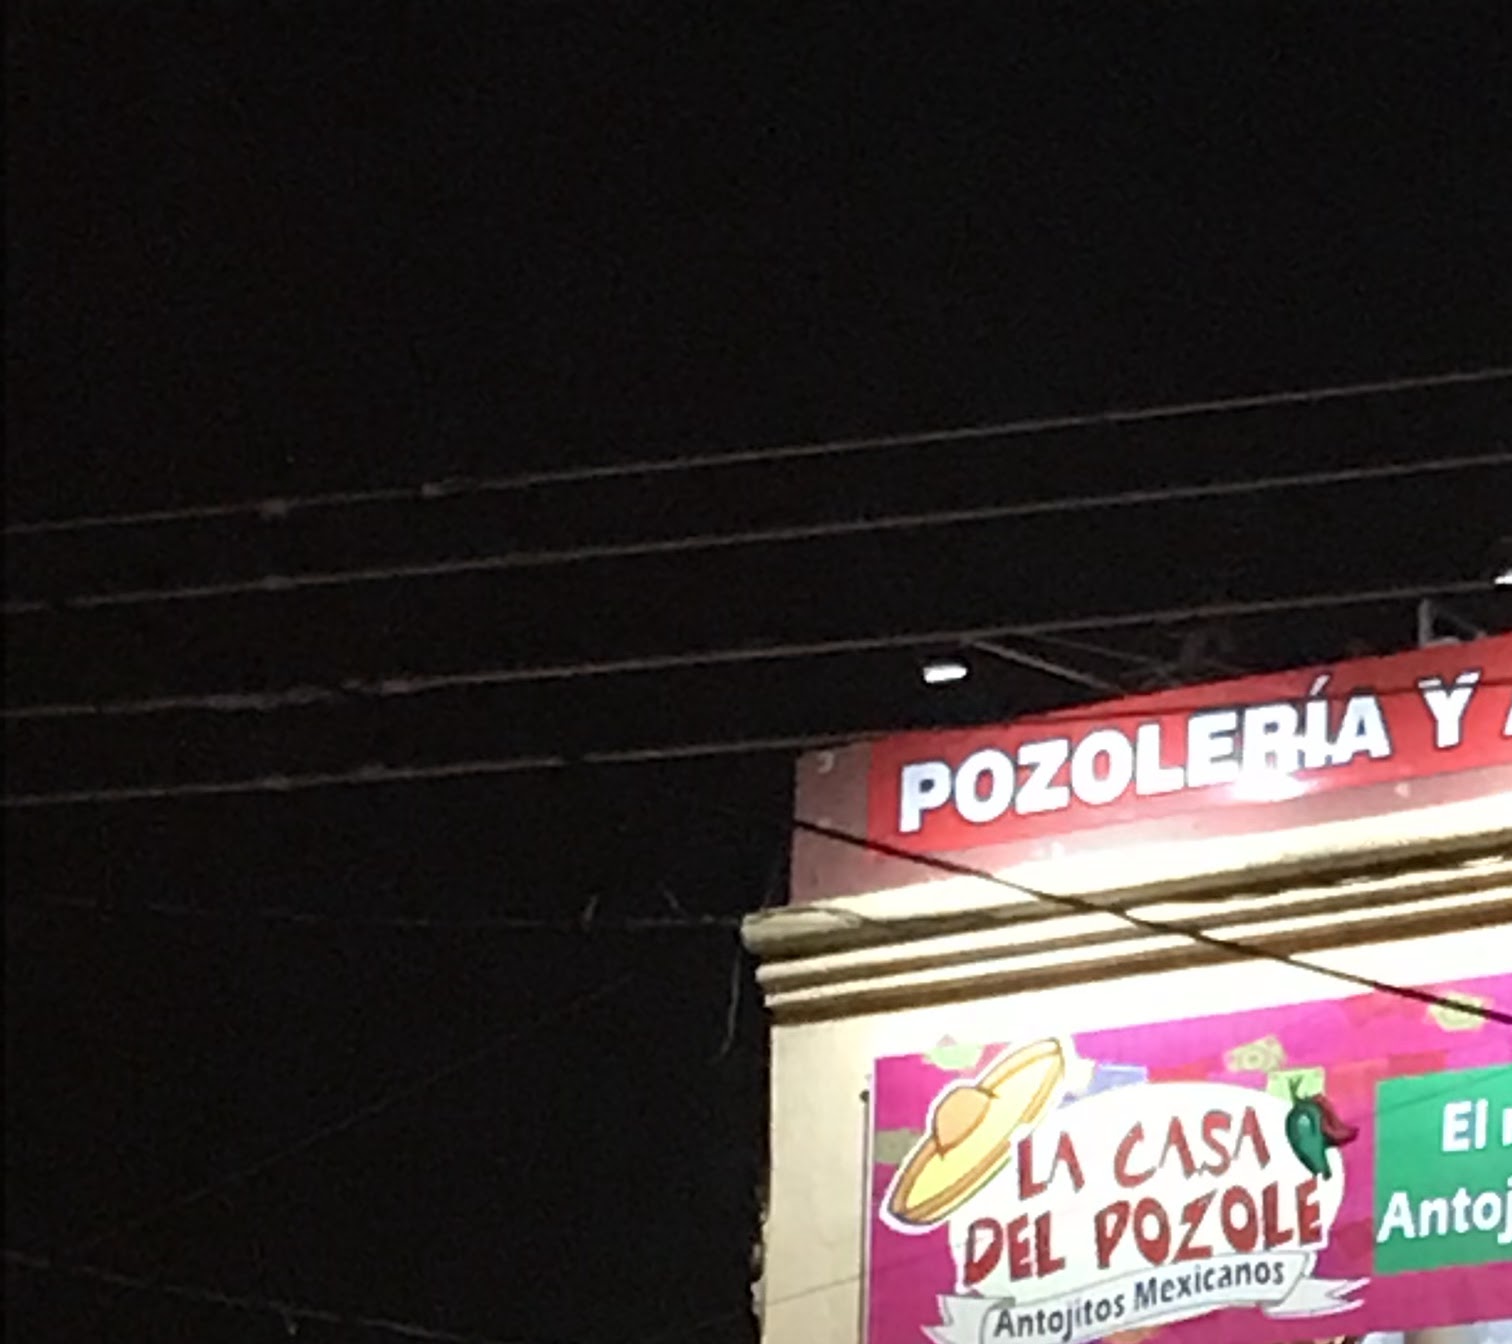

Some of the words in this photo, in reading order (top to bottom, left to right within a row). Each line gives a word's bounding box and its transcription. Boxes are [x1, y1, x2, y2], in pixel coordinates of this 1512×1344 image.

[899, 674, 1391, 834] POZOLERÍA
[1417, 670, 1481, 748] Y
[1017, 1131, 1085, 1200] LA
[1113, 1105, 1270, 1188] CASA
[1442, 1099, 1487, 1151] El
[963, 1211, 1065, 1286] DEL
[1094, 1178, 1323, 1270] POZOLE
[993, 1287, 1125, 1342] Antojitos
[1134, 1260, 1284, 1312] Mexicanos
